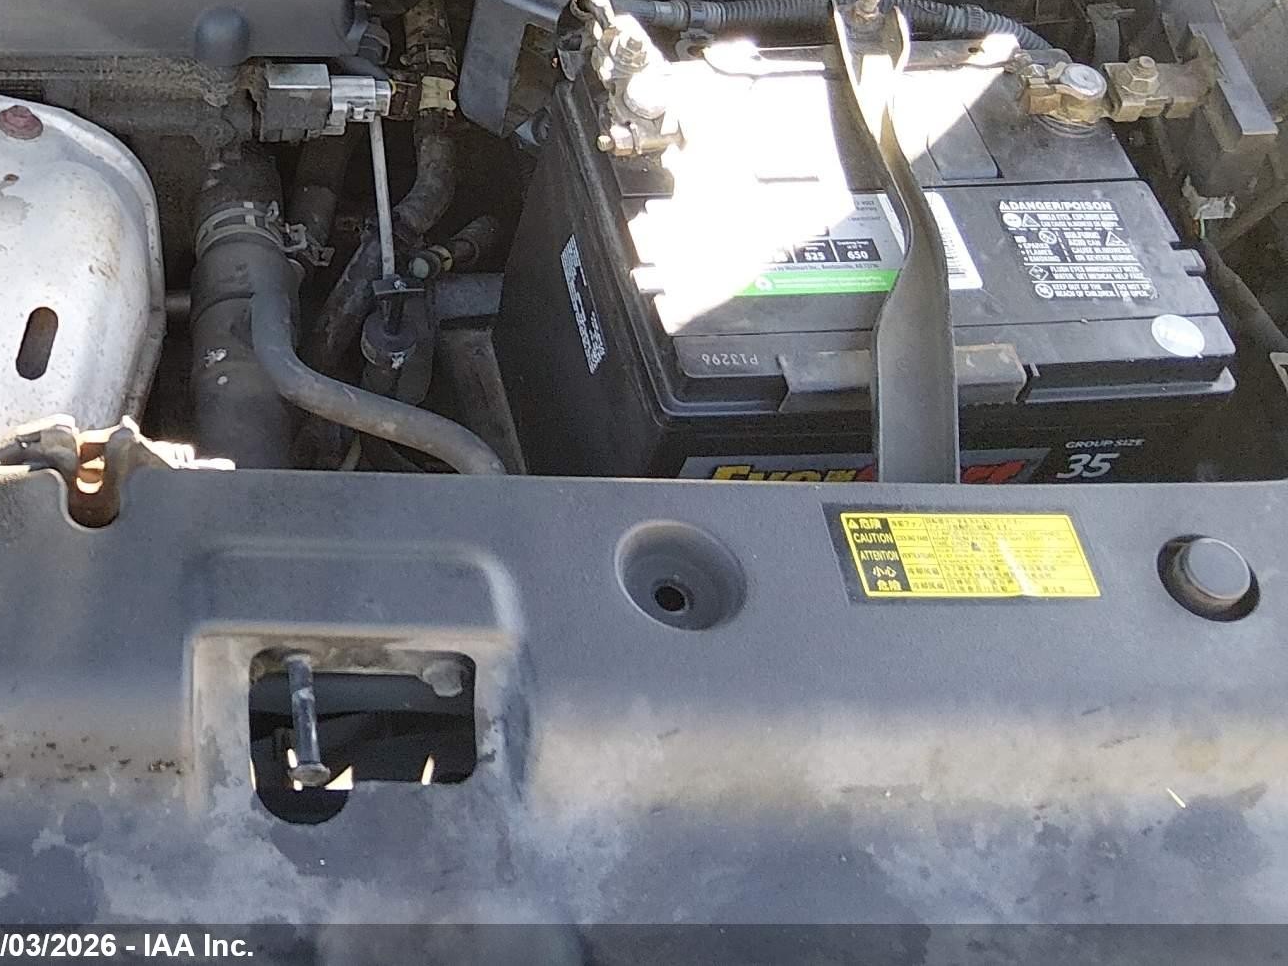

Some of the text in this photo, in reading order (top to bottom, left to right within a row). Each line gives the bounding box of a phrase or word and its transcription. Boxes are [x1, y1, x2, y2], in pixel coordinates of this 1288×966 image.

[1009, 201, 1113, 210] DANGER/POISON
[847, 250, 869, 260] 650
[1065, 439, 1145, 449] GROUP SIZE
[1056, 453, 1120, 479] 35
[852, 532, 893, 543] CAUTION
[857, 550, 900, 560] ATTENTION
